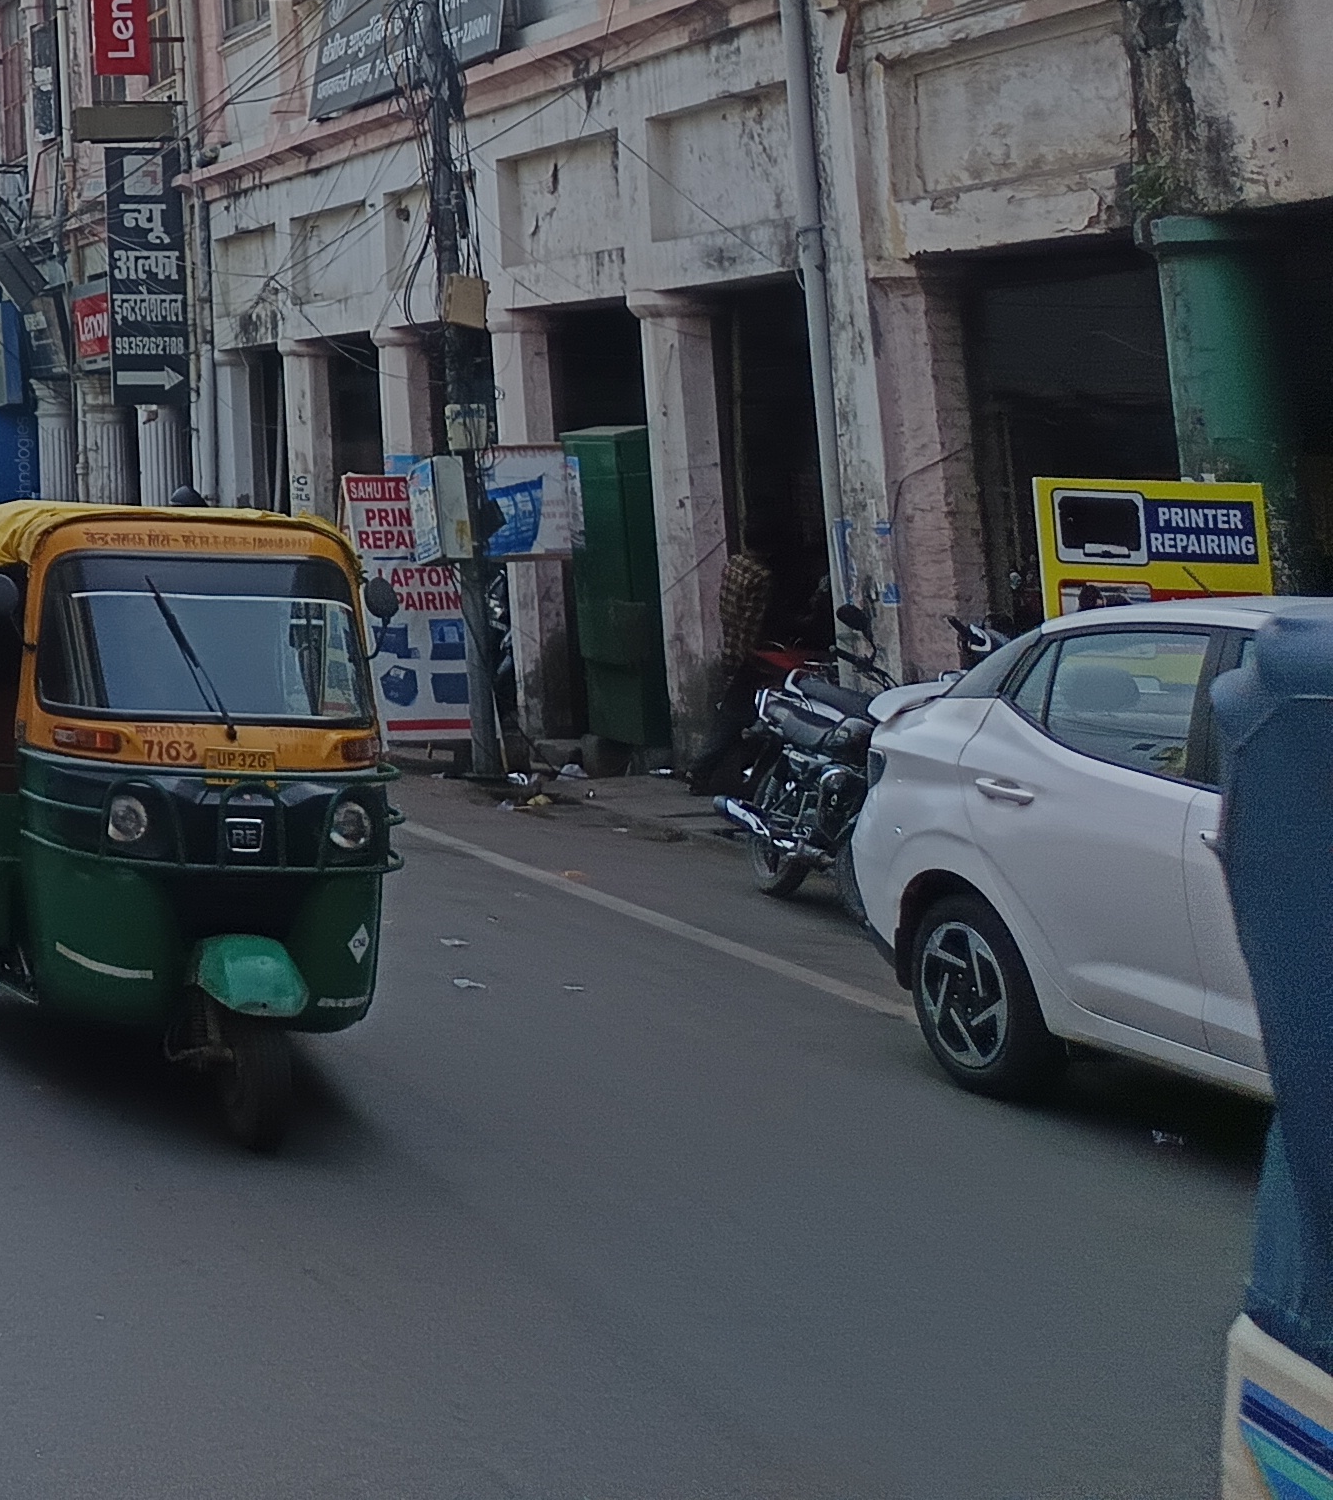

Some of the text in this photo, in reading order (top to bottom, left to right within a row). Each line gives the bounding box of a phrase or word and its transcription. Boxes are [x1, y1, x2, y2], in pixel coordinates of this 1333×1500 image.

[119, 203, 171, 244] न्यू
[113, 250, 179, 280] अल्फा
[14, 416, 35, 499] hnologies
[349, 481, 382, 499] SAHU
[385, 481, 396, 499] IT
[364, 508, 412, 527] PRIN
[1158, 507, 1243, 529] PRINTER
[1150, 533, 1256, 556] REPAIRING
[143, 739, 198, 763] 7163
